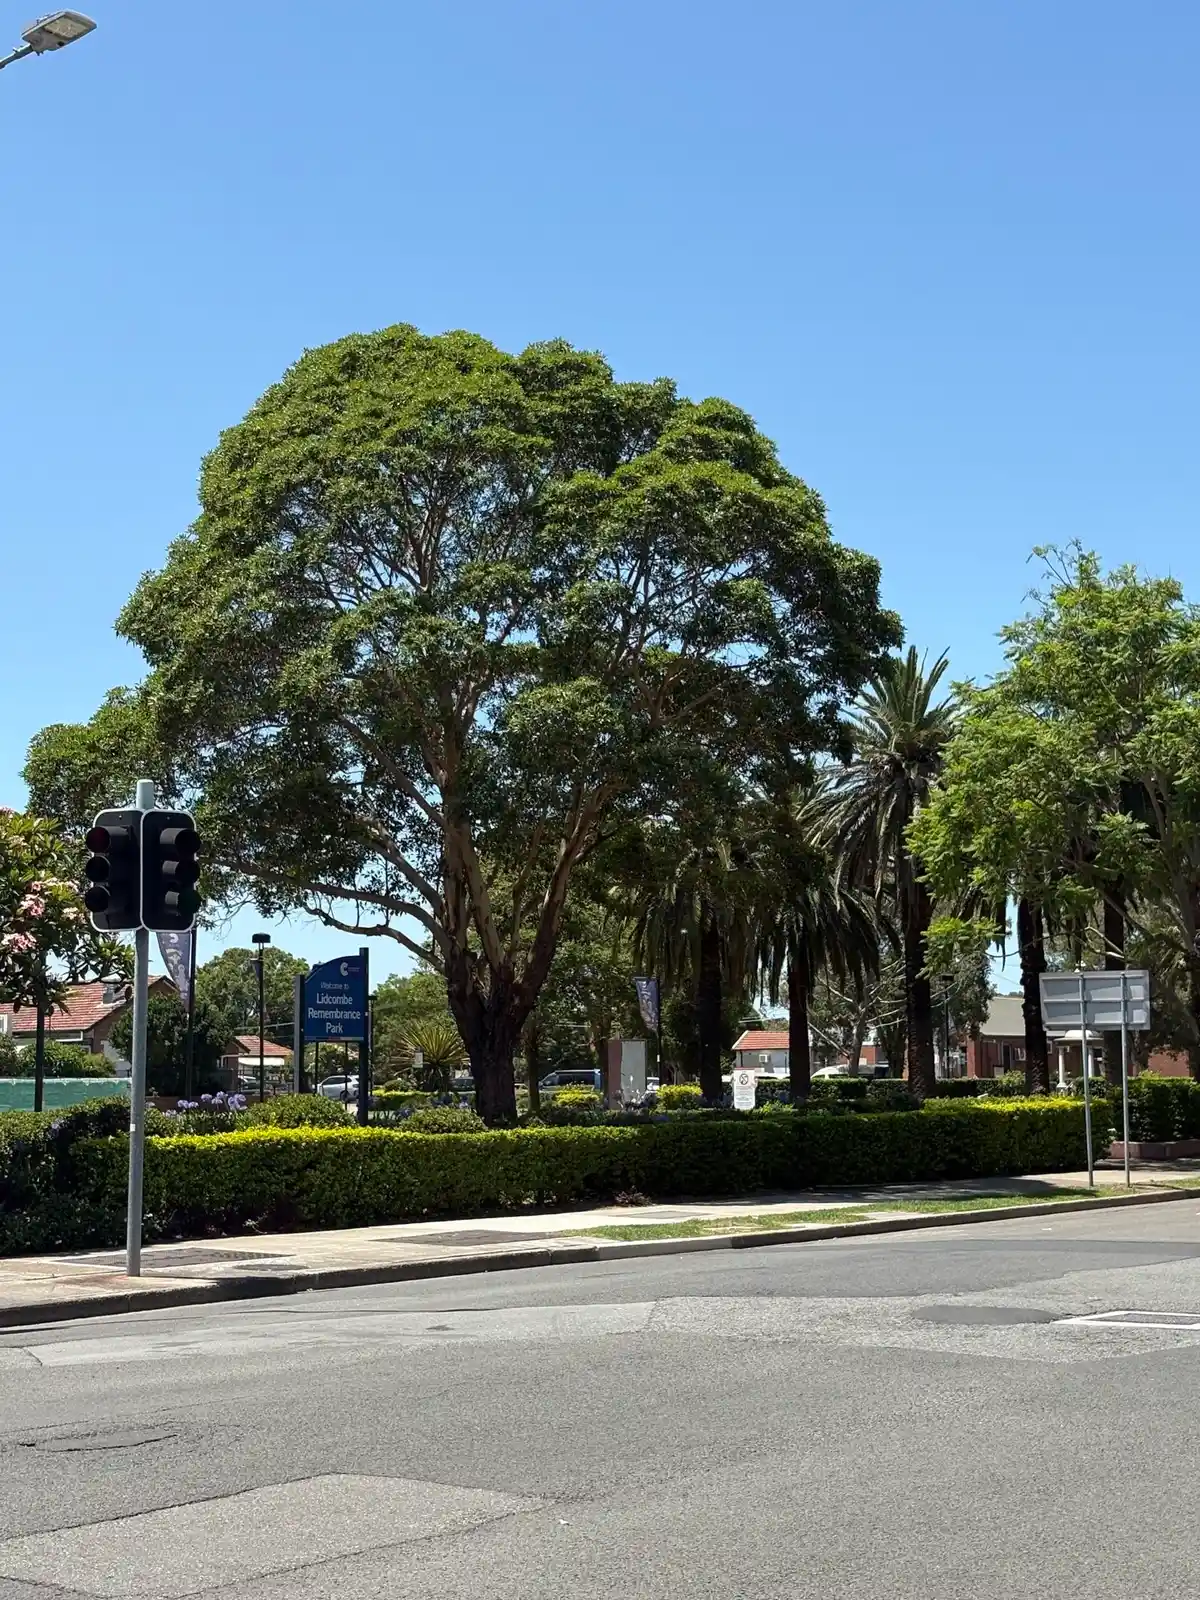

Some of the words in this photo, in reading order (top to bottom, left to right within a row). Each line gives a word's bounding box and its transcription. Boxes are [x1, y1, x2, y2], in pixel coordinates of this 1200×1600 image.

[320, 981, 343, 990] Welcome
[316, 992, 353, 1005] Lidcombe
[307, 1007, 361, 1019] Remembrance
[325, 1022, 343, 1034] Park
